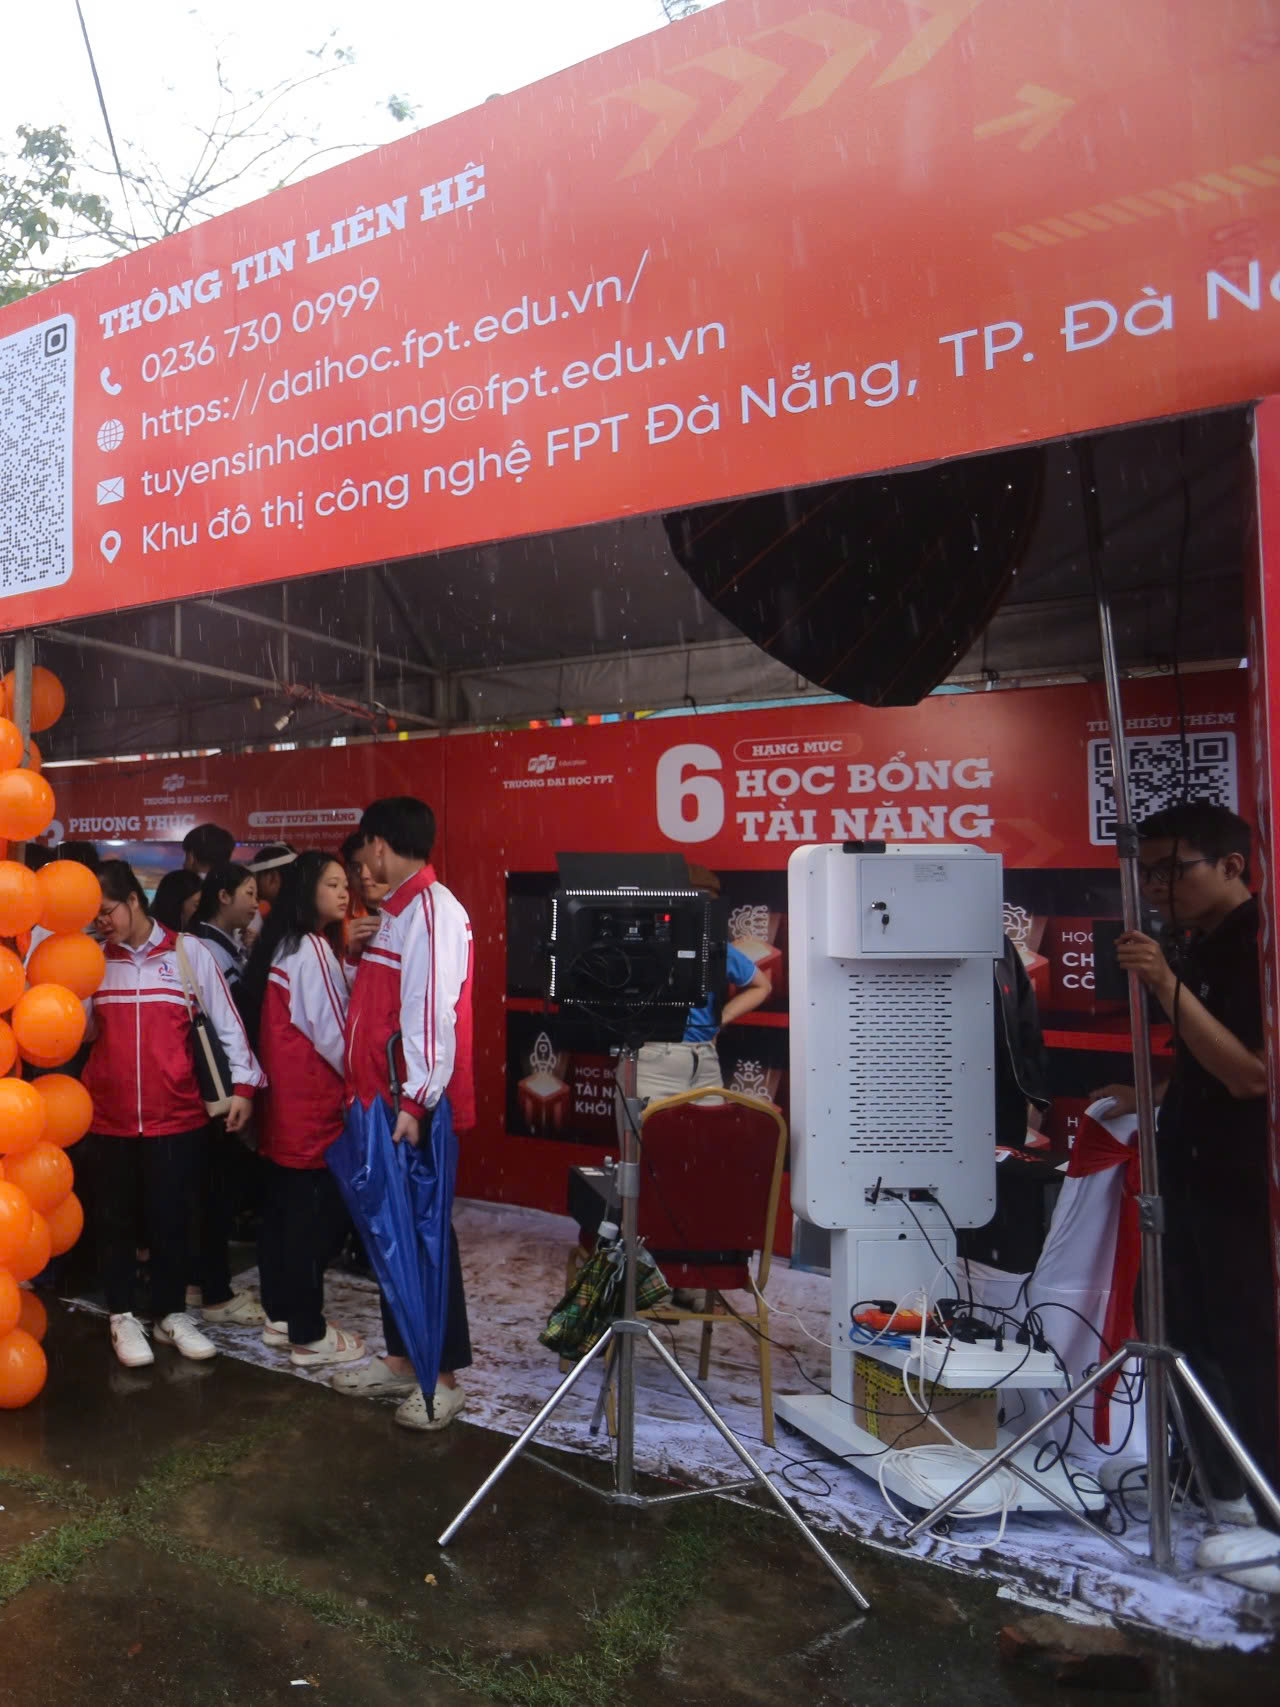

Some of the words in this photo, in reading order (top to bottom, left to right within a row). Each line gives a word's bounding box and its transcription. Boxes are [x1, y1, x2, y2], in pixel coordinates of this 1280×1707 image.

[99, 269, 223, 340] THÔNG
[231, 240, 296, 292] TIN
[306, 195, 408, 265] LIÊN
[419, 162, 487, 223] HỆ
[141, 335, 217, 384] 0236
[224, 312, 282, 358] 730
[292, 276, 381, 334] 0999
[141, 249, 650, 441] https://daihoc.fpt.edu.vn/
[140, 322, 726, 498] tuyensinhdanang@fpt.edu.vn
[142, 520, 198, 554] Khu
[208, 502, 253, 540] đô
[261, 490, 305, 533] thị
[315, 474, 409, 516] công
[424, 439, 532, 498] nghệ
[547, 412, 629, 467] FPT
[645, 394, 720, 445] Đà
[741, 362, 919, 425] Nẵng,
[939, 320, 1034, 377] TP.
[1060, 286, 1174, 353] Đà
[527, 753, 557, 774] FPT
[593, 774, 614, 785] FPT
[656, 743, 725, 843] 6
[735, 765, 835, 802] HỌC
[847, 751, 994, 794] BỔNG
[735, 802, 818, 843] TÀI
[831, 800, 995, 841] NĂNG
